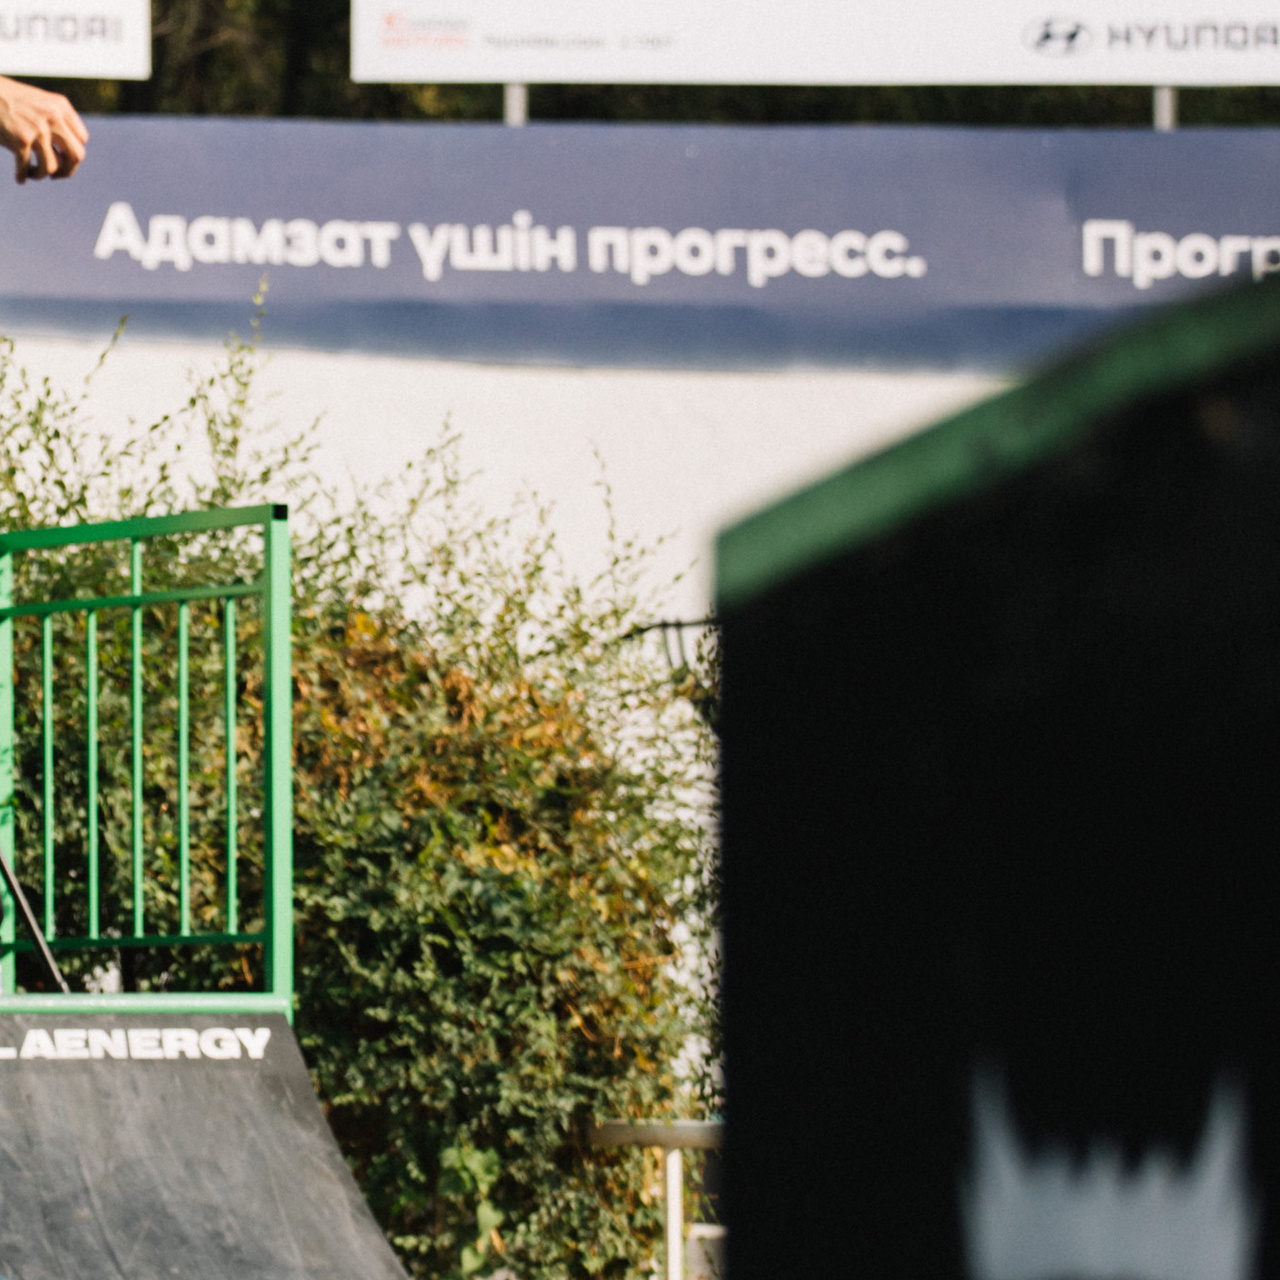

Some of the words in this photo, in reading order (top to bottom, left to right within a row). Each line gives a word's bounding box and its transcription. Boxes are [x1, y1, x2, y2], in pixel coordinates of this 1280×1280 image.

[93, 201, 400, 272] Адамзат
[407, 209, 577, 282] үшін
[586, 223, 928, 288] прогресс.
